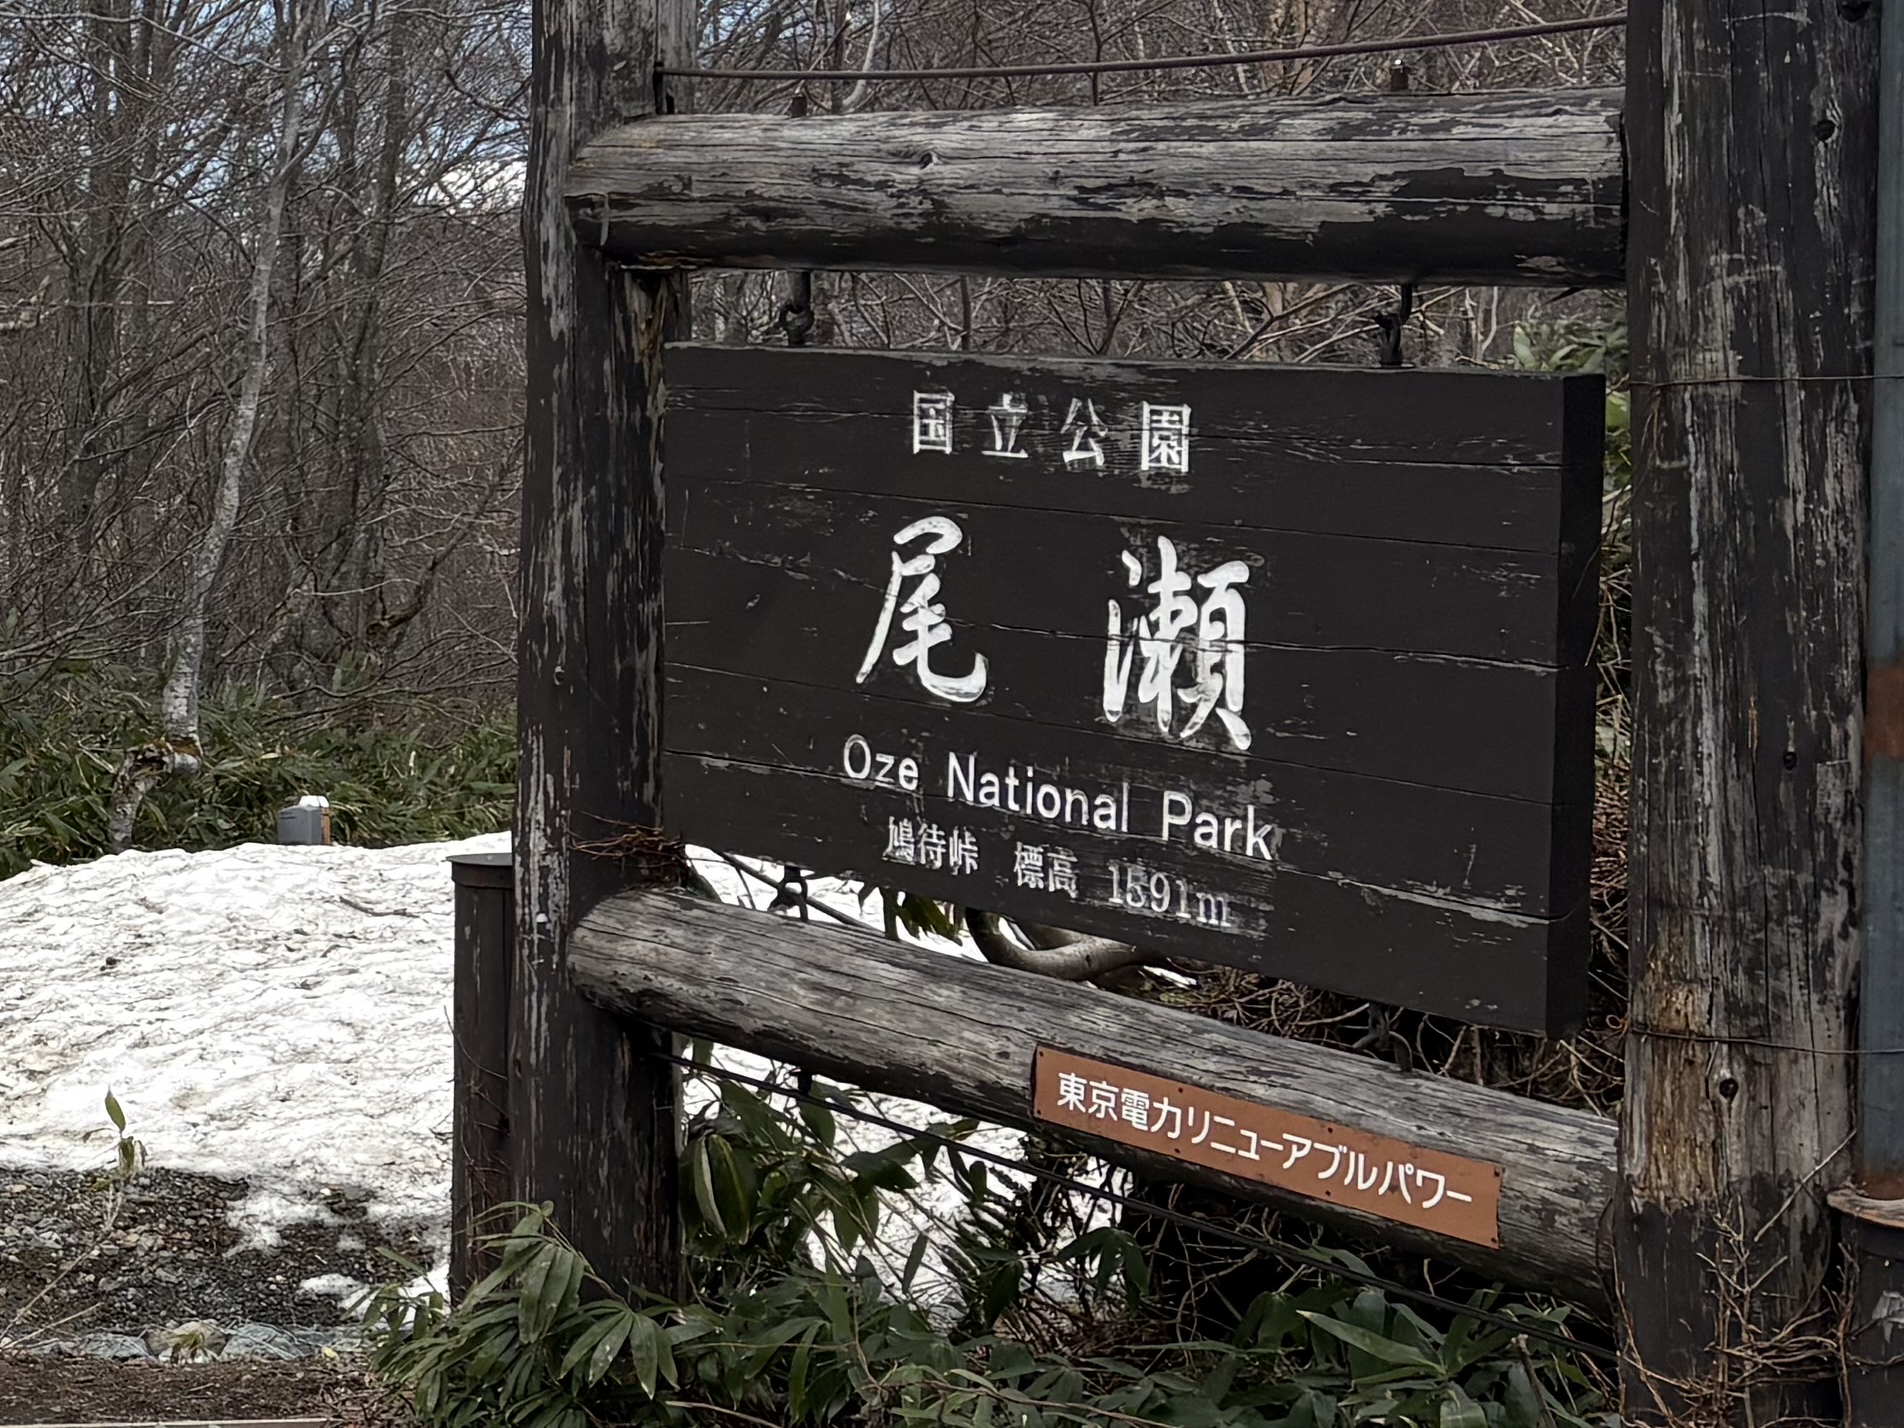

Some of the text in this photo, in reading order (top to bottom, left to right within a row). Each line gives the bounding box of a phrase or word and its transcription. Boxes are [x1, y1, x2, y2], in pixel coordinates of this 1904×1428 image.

[913, 390, 1192, 472] 国立公園
[855, 515, 1252, 751] 尾瀬
[843, 733, 1274, 860] Oze National Park
[882, 816, 1232, 928] 鳩待峠 標高 1591m
[1057, 1072, 1473, 1209] 東京電力リニューアブルパワー
